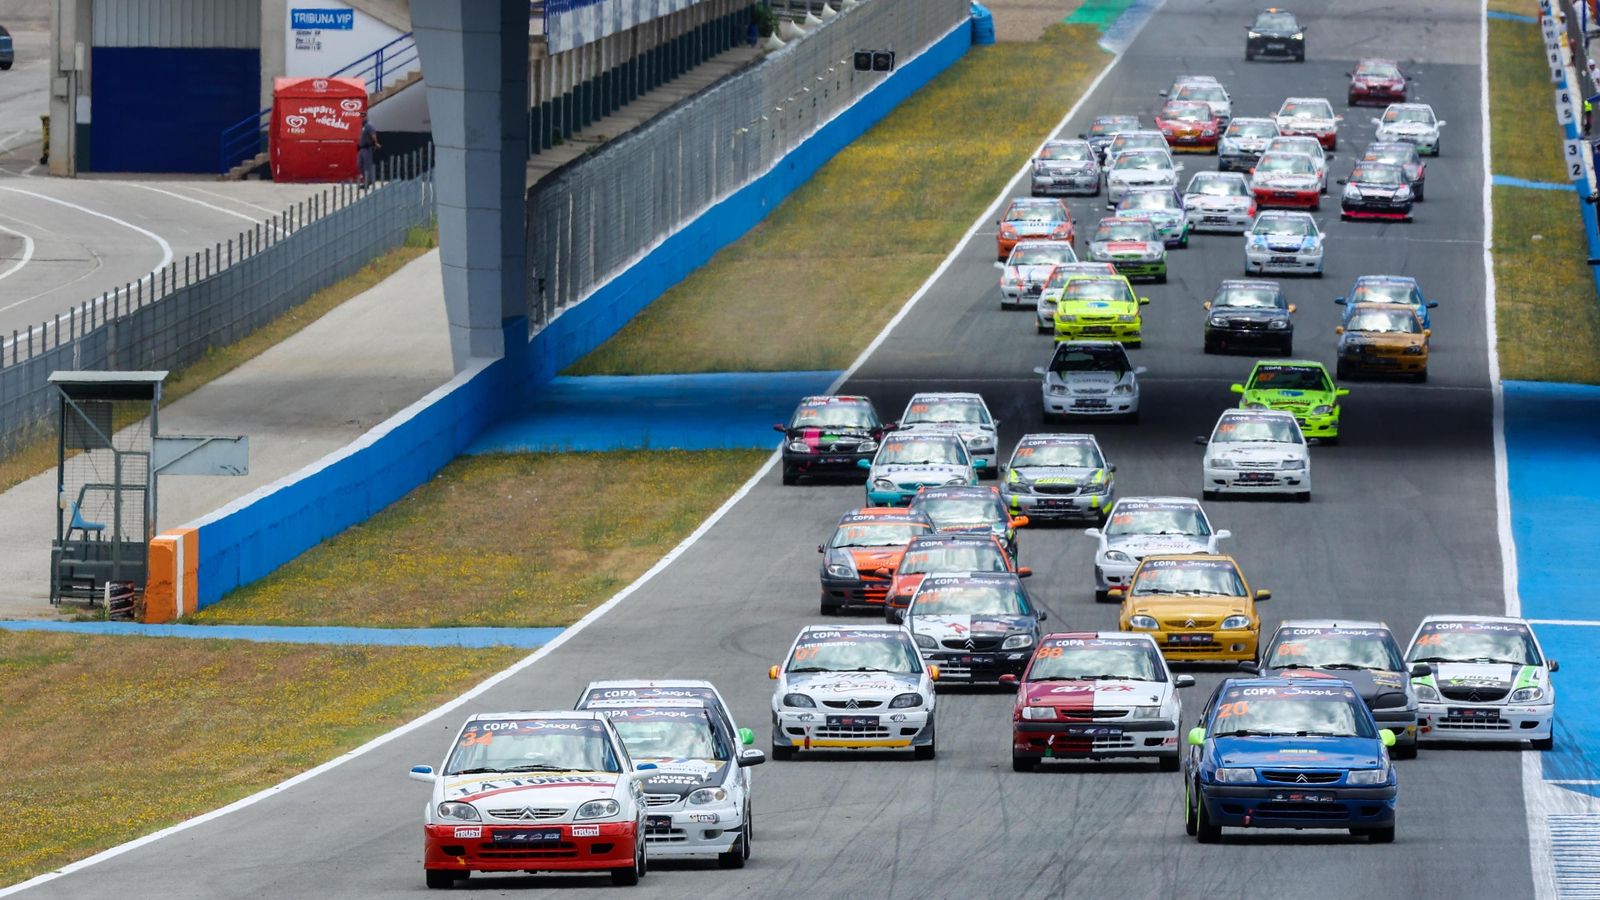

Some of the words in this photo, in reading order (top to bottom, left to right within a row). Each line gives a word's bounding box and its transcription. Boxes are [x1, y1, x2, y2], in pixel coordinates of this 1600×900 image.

[293, 13, 336, 23] TRIBUNA
[337, 13, 351, 23] VIP
[1561, 93, 1568, 103] 6
[1564, 109, 1571, 119] 5
[1568, 146, 1577, 156] 3
[1572, 165, 1581, 176] 2
[1036, 647, 1063, 659] 88
[604, 690, 637, 698] COPA
[1243, 688, 1276, 696] COPA
[1217, 701, 1249, 718] 20
[483, 722, 518, 731] COPA
[460, 731, 494, 747] 34
[459, 781, 500, 796] LA
[509, 776, 604, 788] TORRE
[573, 828, 599, 836] TRUST
